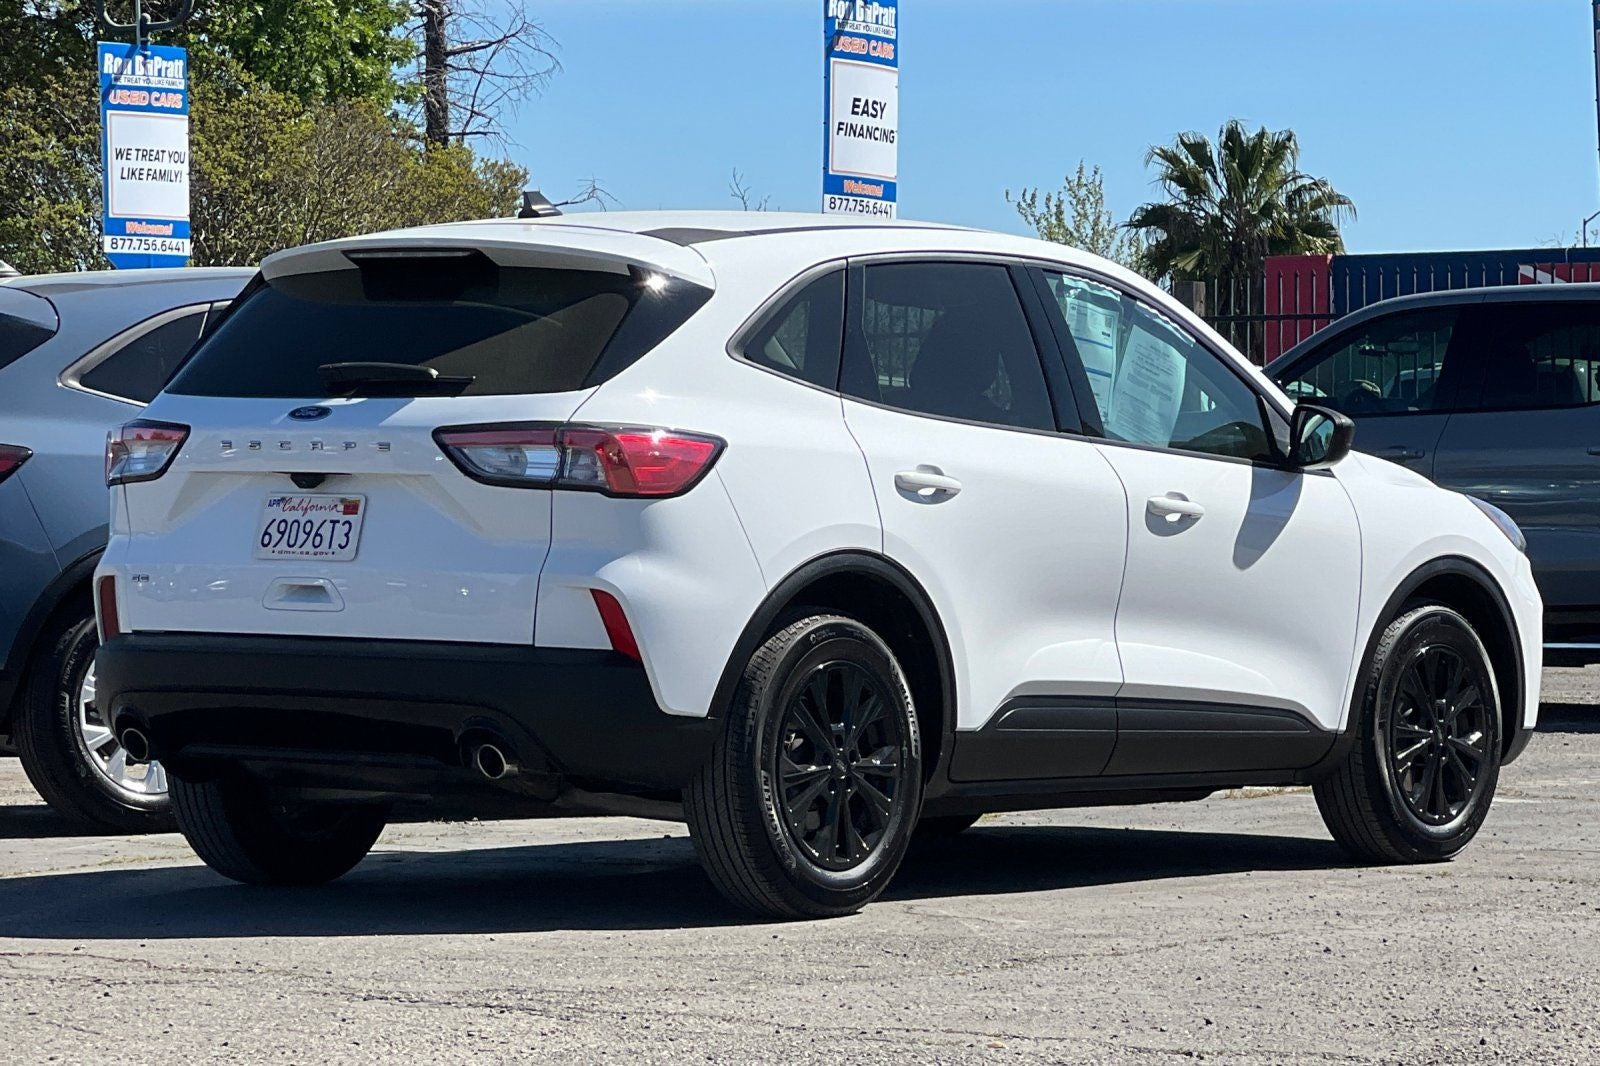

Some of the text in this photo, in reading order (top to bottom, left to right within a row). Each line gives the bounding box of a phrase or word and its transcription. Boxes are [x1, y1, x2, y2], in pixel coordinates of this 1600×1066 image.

[833, 35, 895, 60] USED CARS
[103, 52, 132, 75] Ron
[124, 76, 141, 84] TREAT
[143, 78, 154, 86] YOU
[155, 78, 165, 87] LIKE
[109, 89, 184, 109] USED CARS
[851, 97, 887, 120] EASY
[836, 121, 895, 144] FINANCING
[115, 147, 186, 164] WE TREAT YOU
[120, 166, 183, 183] LIKE FAMILY!
[843, 179, 884, 197] Welcome!
[829, 196, 893, 219] 877.756.6441
[125, 220, 174, 236] Welcome!
[110, 237, 185, 253] 877.756.6441
[220, 440, 391, 451] ESCAPE
[281, 496, 343, 517] California
[260, 518, 353, 550] 69096T3
